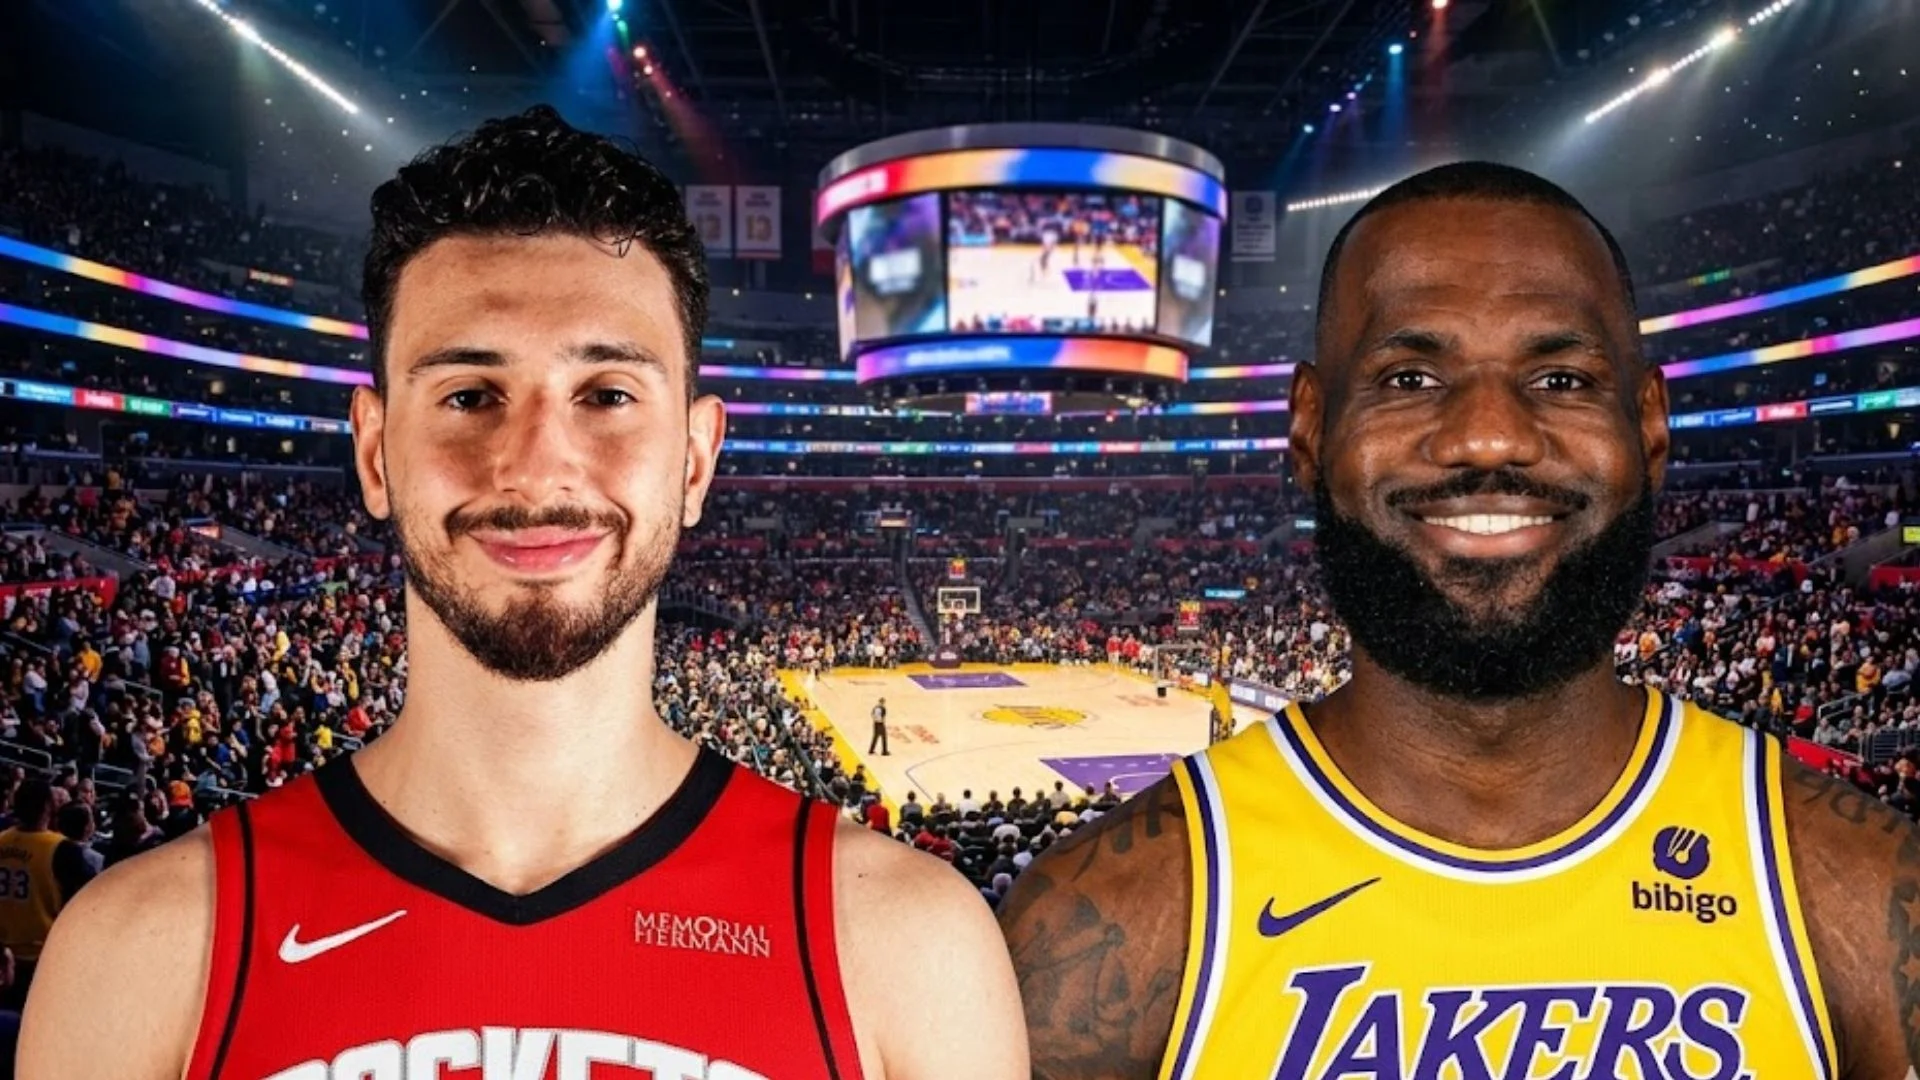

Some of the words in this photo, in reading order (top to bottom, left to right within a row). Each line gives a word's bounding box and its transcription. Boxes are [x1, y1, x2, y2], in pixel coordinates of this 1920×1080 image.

[1632, 881, 1737, 923] bibigo
[634, 910, 765, 943] MEMORIAL
[634, 928, 771, 958] HERMANN
[1269, 963, 1752, 1080] LAKERS
